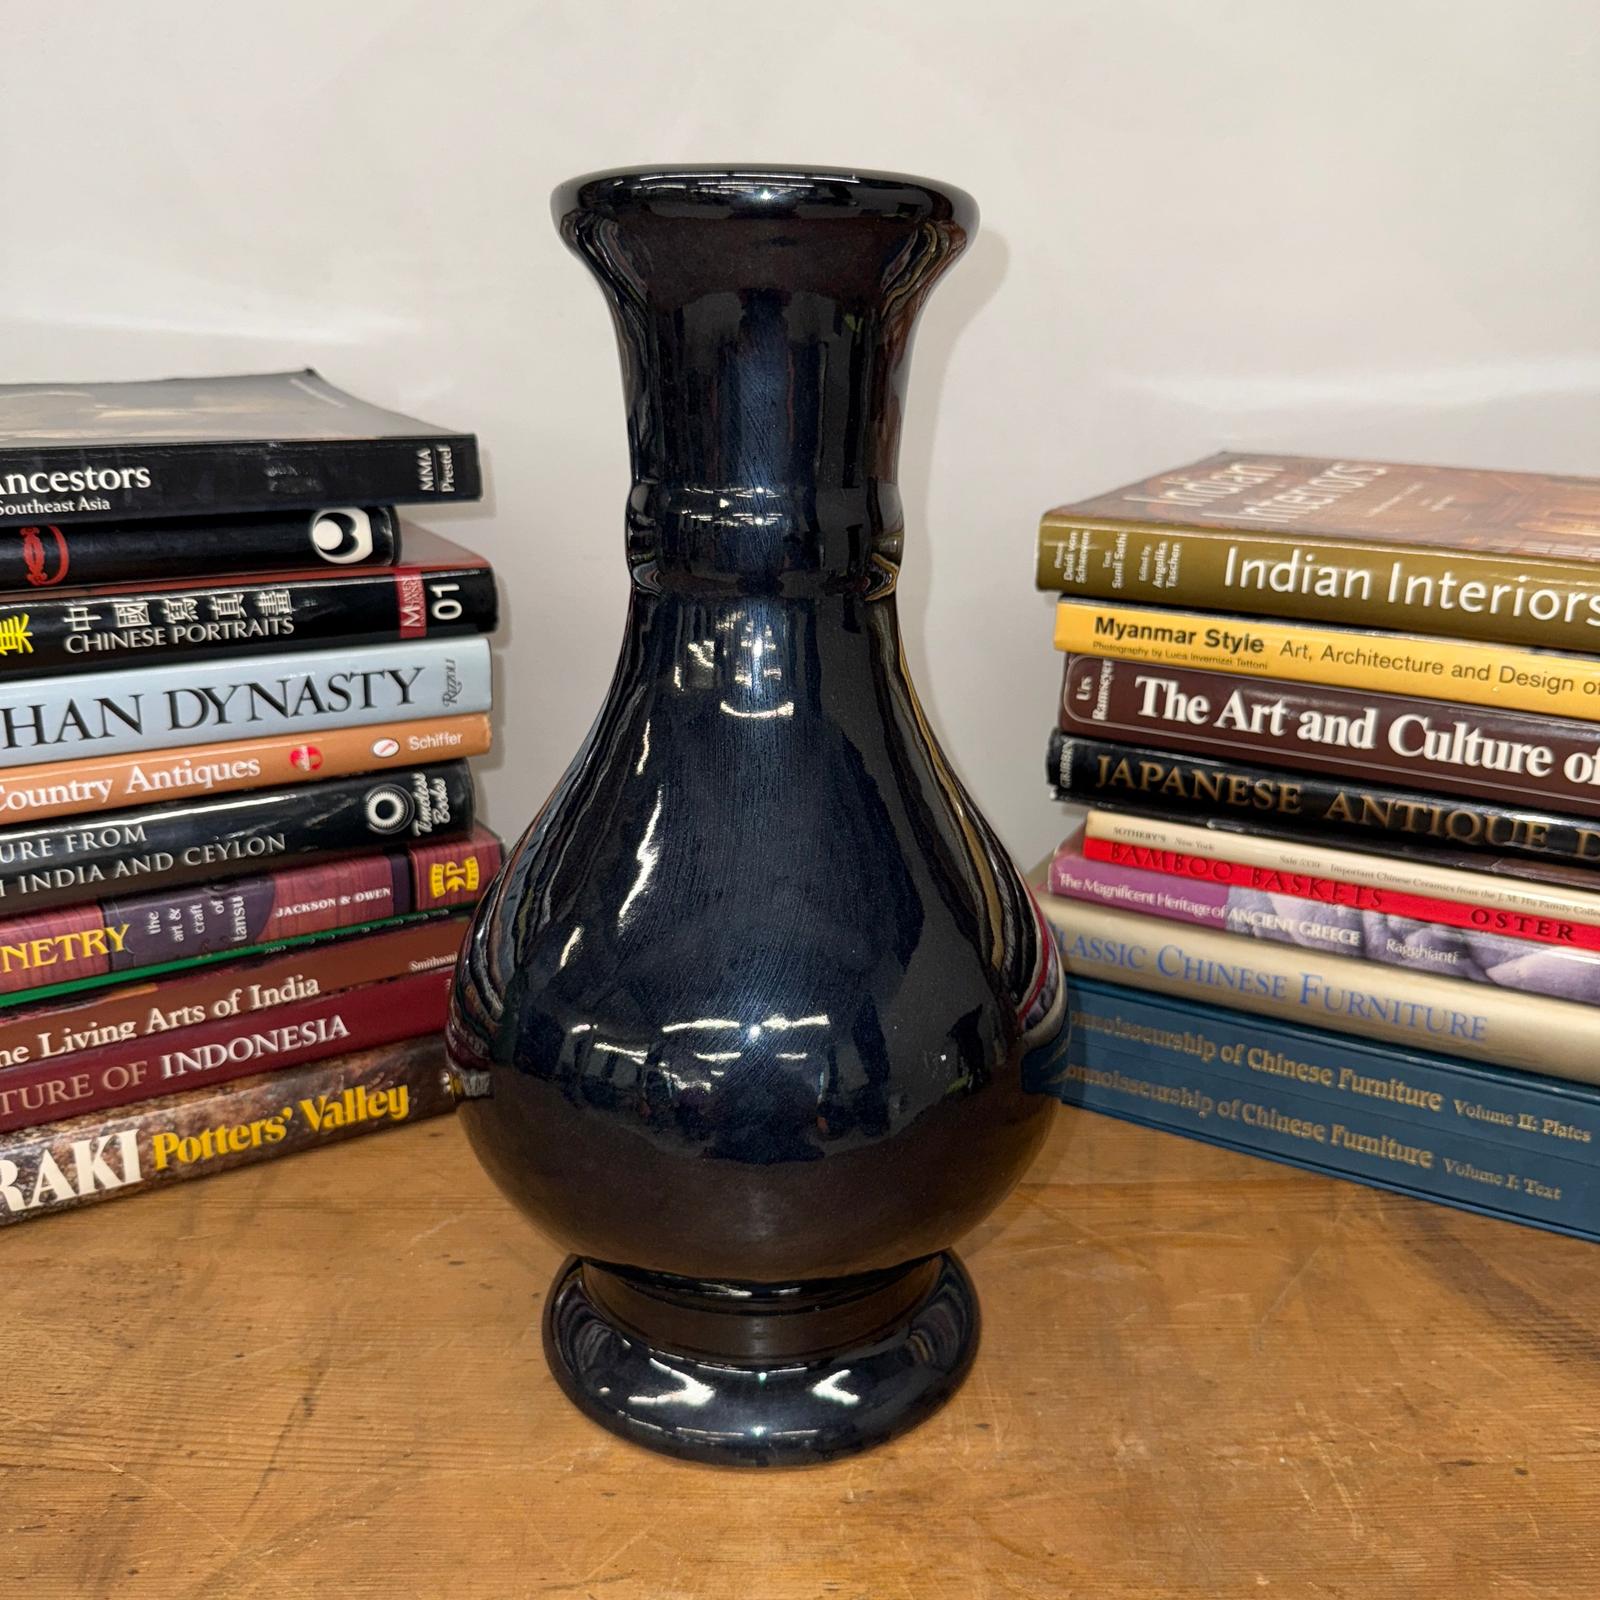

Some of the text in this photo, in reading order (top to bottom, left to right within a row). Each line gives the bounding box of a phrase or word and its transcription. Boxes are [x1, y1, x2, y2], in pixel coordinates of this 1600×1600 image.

[417, 447, 435, 491] MMA
[436, 444, 455, 493] Prestel
[78, 495, 111, 511] Asia
[1112, 561, 1124, 589] Sunil
[1152, 541, 1168, 588] Angelika
[1166, 542, 1181, 588] Taschen
[1223, 546, 1371, 600] Indian
[430, 583, 463, 620] 01
[64, 616, 295, 654] CHINESE PORTRAITS
[1093, 641, 1149, 657] Photography
[1152, 648, 1162, 658] by
[1095, 616, 1197, 645] Myanmar
[1204, 628, 1264, 655] Style
[1279, 640, 1312, 661] Art,
[1320, 644, 1444, 676] Architecture
[1450, 660, 1490, 682] and
[1499, 666, 1574, 695] Design
[0, 666, 426, 749] HAN DYNASTY
[1076, 676, 1093, 701] Urs
[1135, 675, 1212, 726] The
[1214, 689, 1287, 737] Art
[1297, 707, 1377, 750] and
[1388, 713, 1555, 777] Culture
[126, 758, 261, 794] Antiques
[408, 731, 463, 751] Schiffer
[411, 771, 433, 837] Timeless
[429, 776, 451, 825] Books
[1097, 753, 1303, 815] JAPANESE
[1324, 791, 1550, 848] ANTIQUE
[0, 824, 148, 864] URE FROM
[19, 863, 105, 894] INDIA
[114, 852, 174, 879] AND
[183, 832, 287, 867] CEYLON
[1110, 842, 1576, 942] BAMBOO BASKETS OSTER
[1113, 825, 1167, 843] SOTHEBY'S
[1175, 838, 1193, 848] New
[1196, 840, 1216, 852] York
[1330, 863, 1374, 881] Important
[1376, 871, 1412, 885] Chinese
[1413, 878, 1455, 893] Ceramics
[1457, 884, 1479, 897] from
[1481, 886, 1495, 898] the
[1539, 899, 1571, 914] Family
[0, 887, 392, 974] NETRY JACKSON & OWEN
[147, 911, 161, 935] the
[169, 907, 185, 943] art &
[189, 903, 205, 935] craft
[210, 899, 225, 915] of
[232, 894, 248, 942] tansu
[1058, 873, 1083, 890] The
[1083, 878, 1154, 904] Magnificent
[1157, 894, 1211, 918] Heritage
[1211, 905, 1225, 920] of
[1227, 906, 1297, 936] ANCIENT
[1298, 917, 1361, 947] GREECE
[1385, 937, 1460, 967] Ragghianti
[1050, 920, 1148, 970] LASSIC
[38, 1019, 136, 1061] Living
[145, 1004, 206, 1034] Arts
[212, 993, 243, 1018] of
[248, 974, 321, 1010] India
[409, 951, 458, 973] Smithsoni
[103, 1060, 148, 1091] OF
[160, 1013, 351, 1080] INDONESIA
[1070, 1009, 1217, 1063] onnoisseurship
[1220, 1042, 1246, 1067] of
[1247, 1047, 1333, 1085] Chinese
[1338, 1068, 1443, 1112] Furniture
[1453, 1098, 1514, 1127] Volume
[1543, 1118, 1591, 1143] Plates
[0, 1084, 409, 1212] RAKI Potters' Valley
[1064, 1063, 1213, 1118] onnoisseurship
[1217, 1098, 1243, 1121] of
[1242, 1104, 1325, 1142] Chinese
[1330, 1124, 1435, 1169] Furniture
[1443, 1157, 1503, 1185] Volume
[1524, 1177, 1562, 1201] Text
